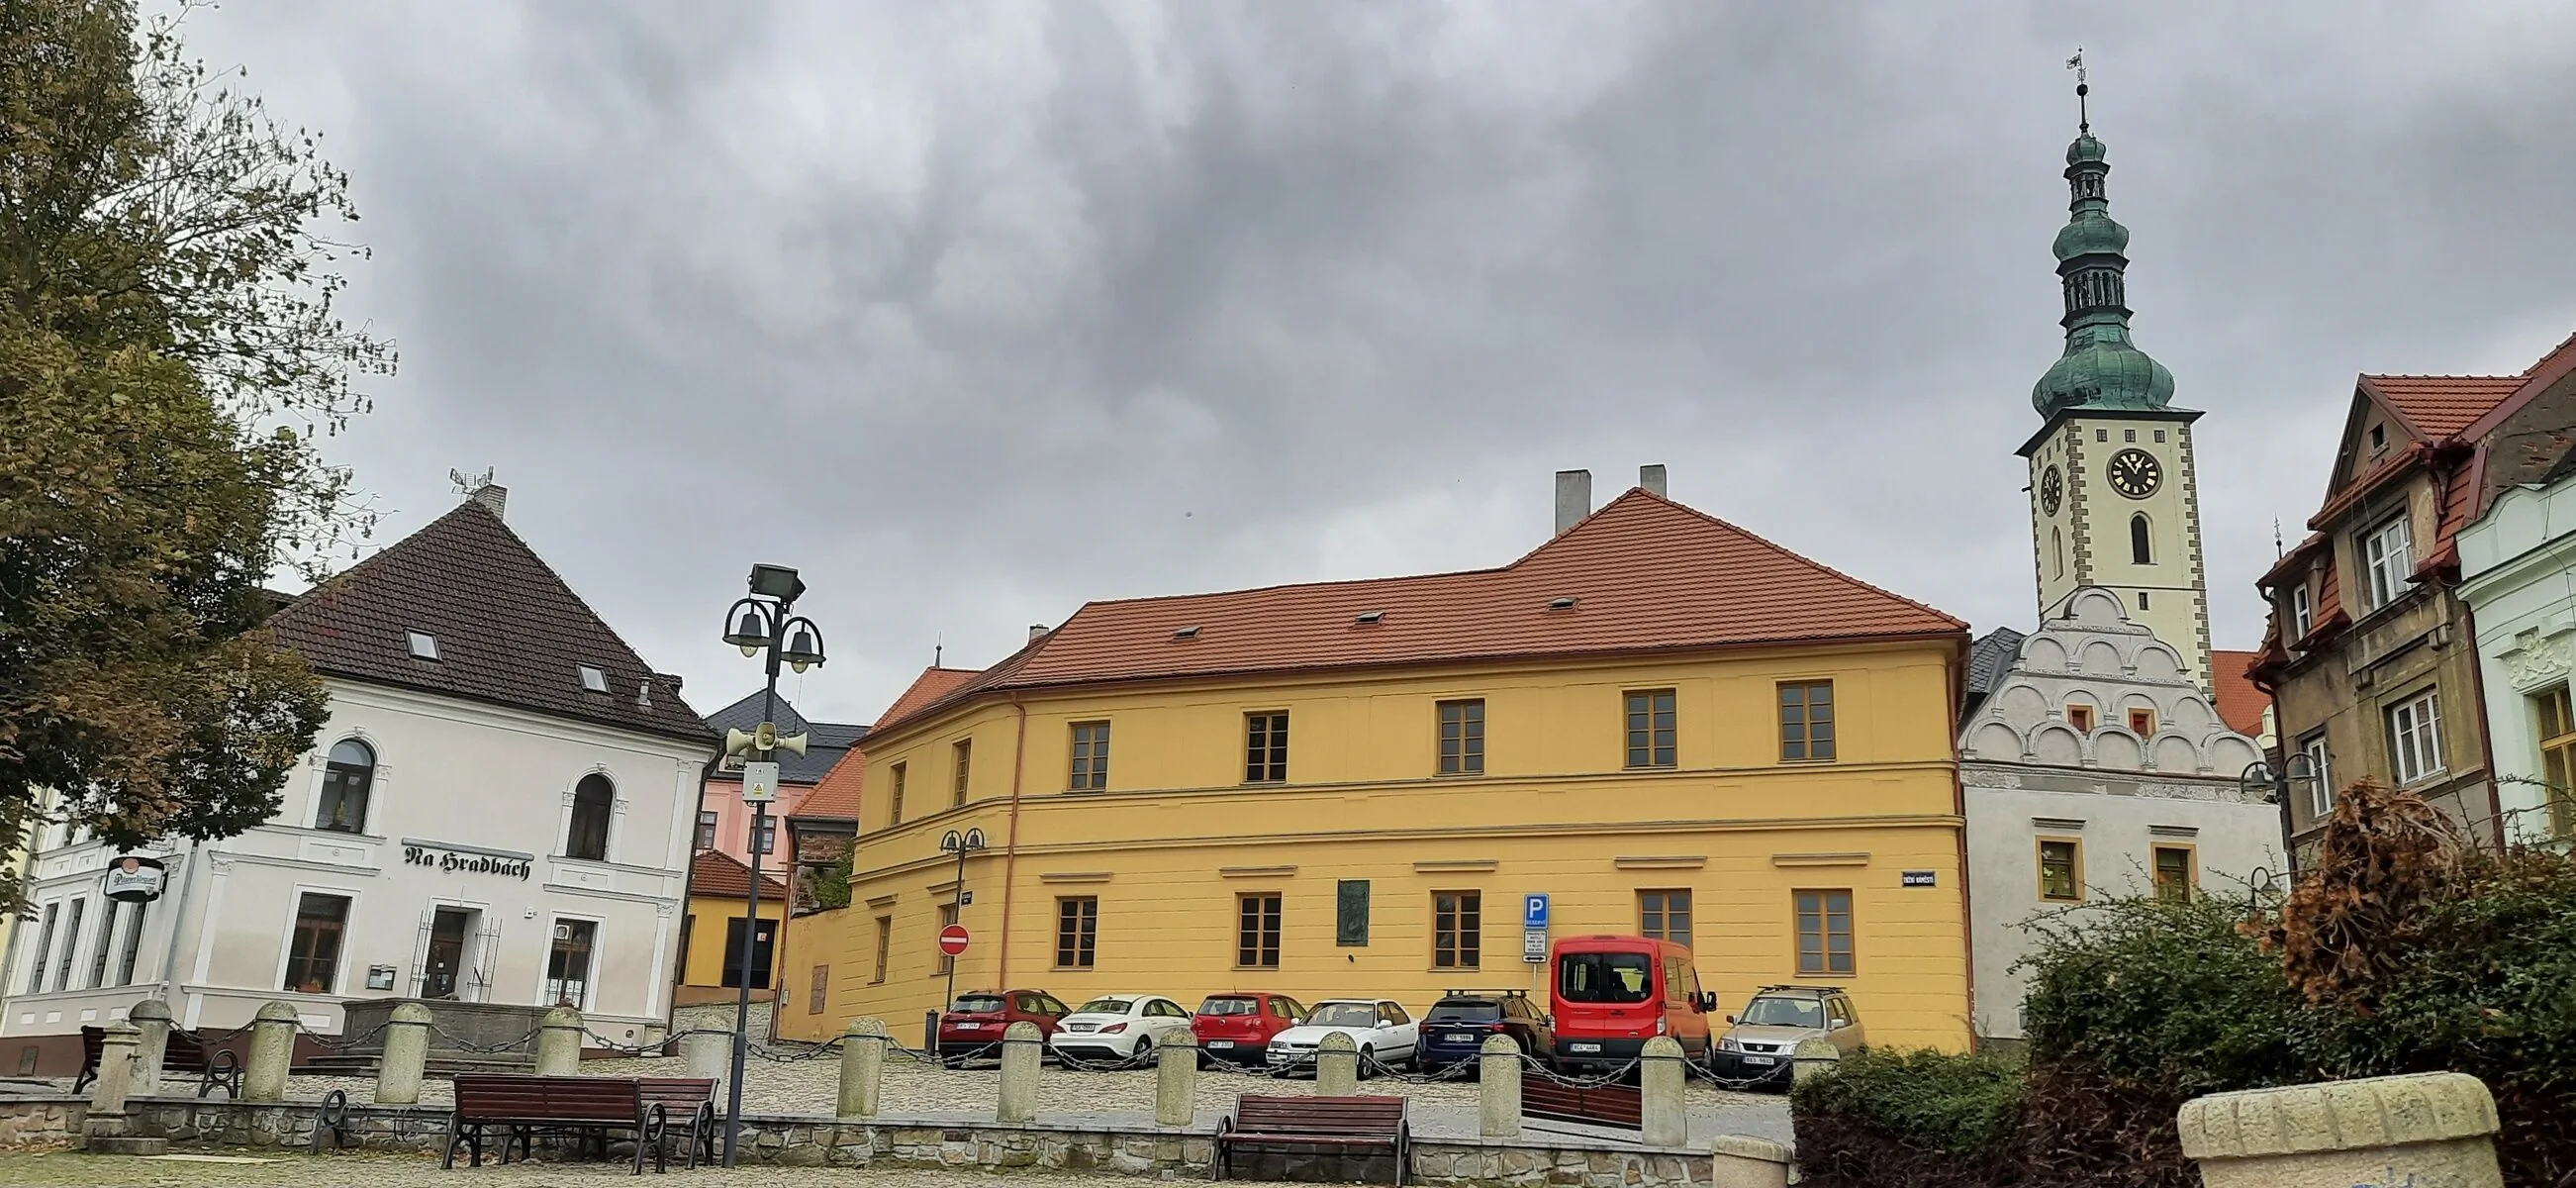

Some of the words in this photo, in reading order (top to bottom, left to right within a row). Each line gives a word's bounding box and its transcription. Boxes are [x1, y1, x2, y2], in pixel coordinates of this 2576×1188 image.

[404, 846, 434, 867] Na
[438, 852, 531, 882] Hradbách
[1530, 898, 1544, 919] P
